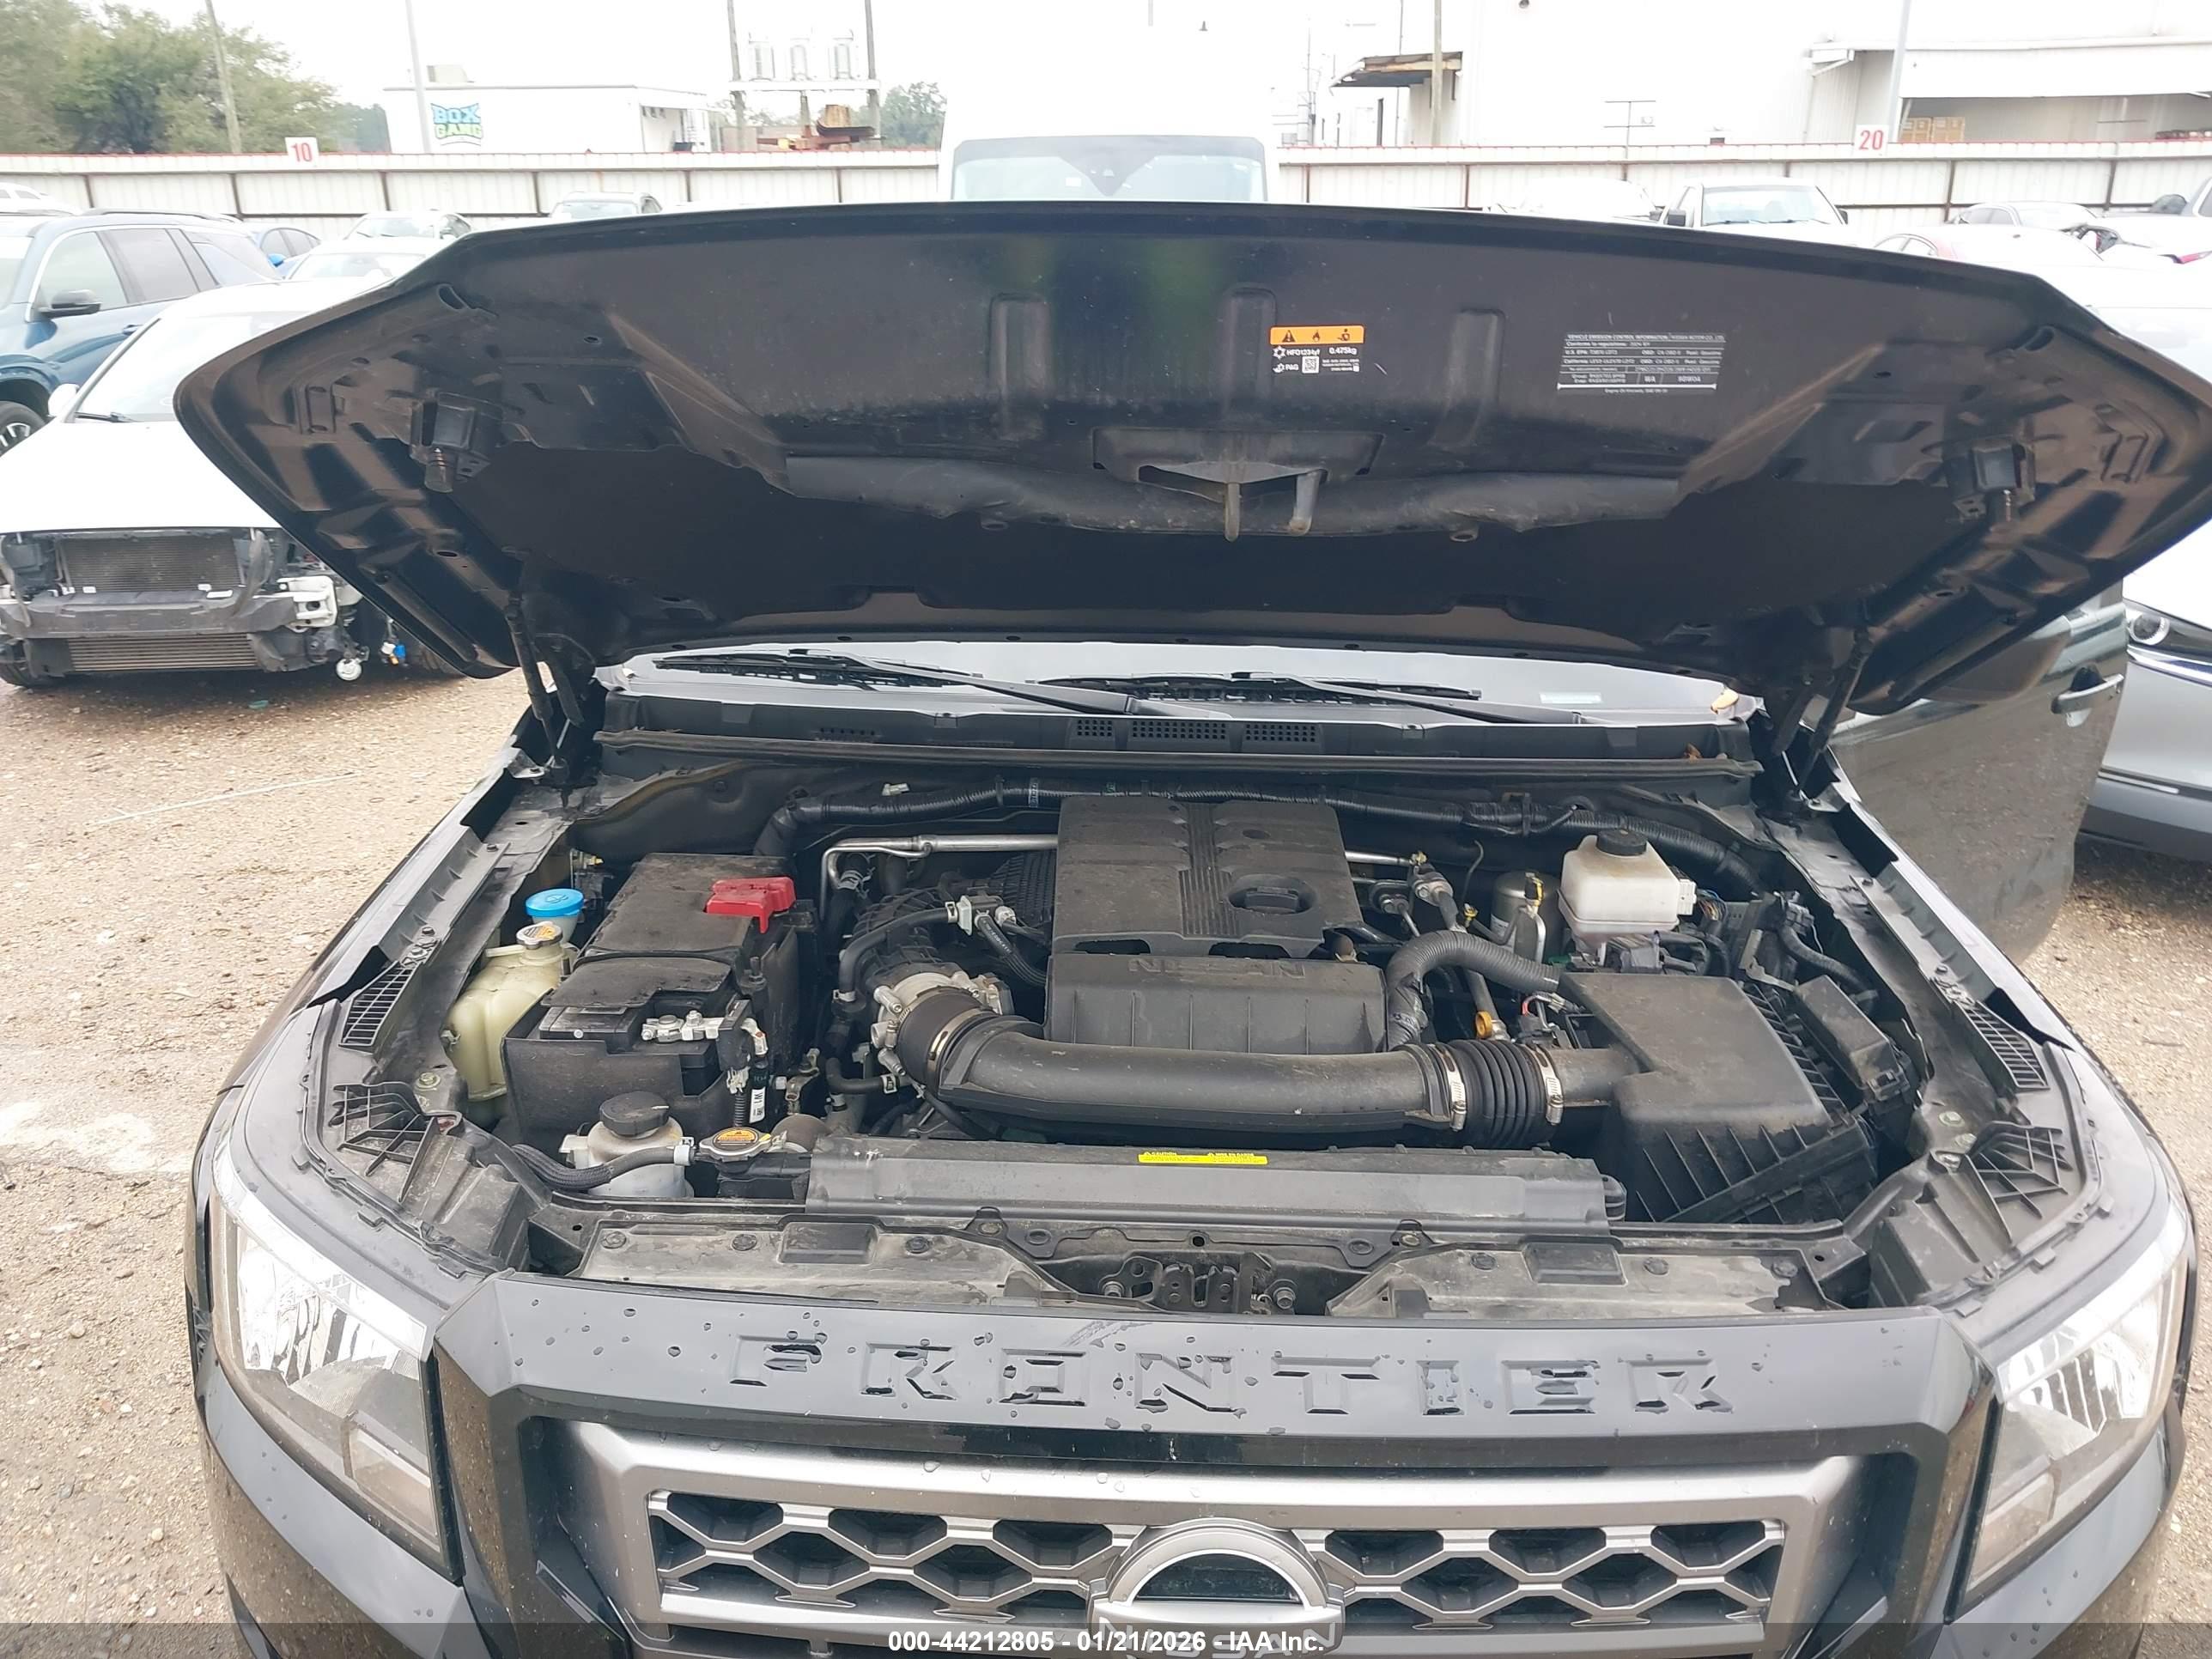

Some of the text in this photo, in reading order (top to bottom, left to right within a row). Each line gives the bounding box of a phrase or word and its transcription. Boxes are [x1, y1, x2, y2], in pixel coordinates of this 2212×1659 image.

[430, 102, 482, 124] BOX
[434, 124, 483, 140] GANG
[1859, 130, 1884, 150] 20
[290, 143, 313, 162] 10
[730, 1334, 1734, 1416] FRONTIER
